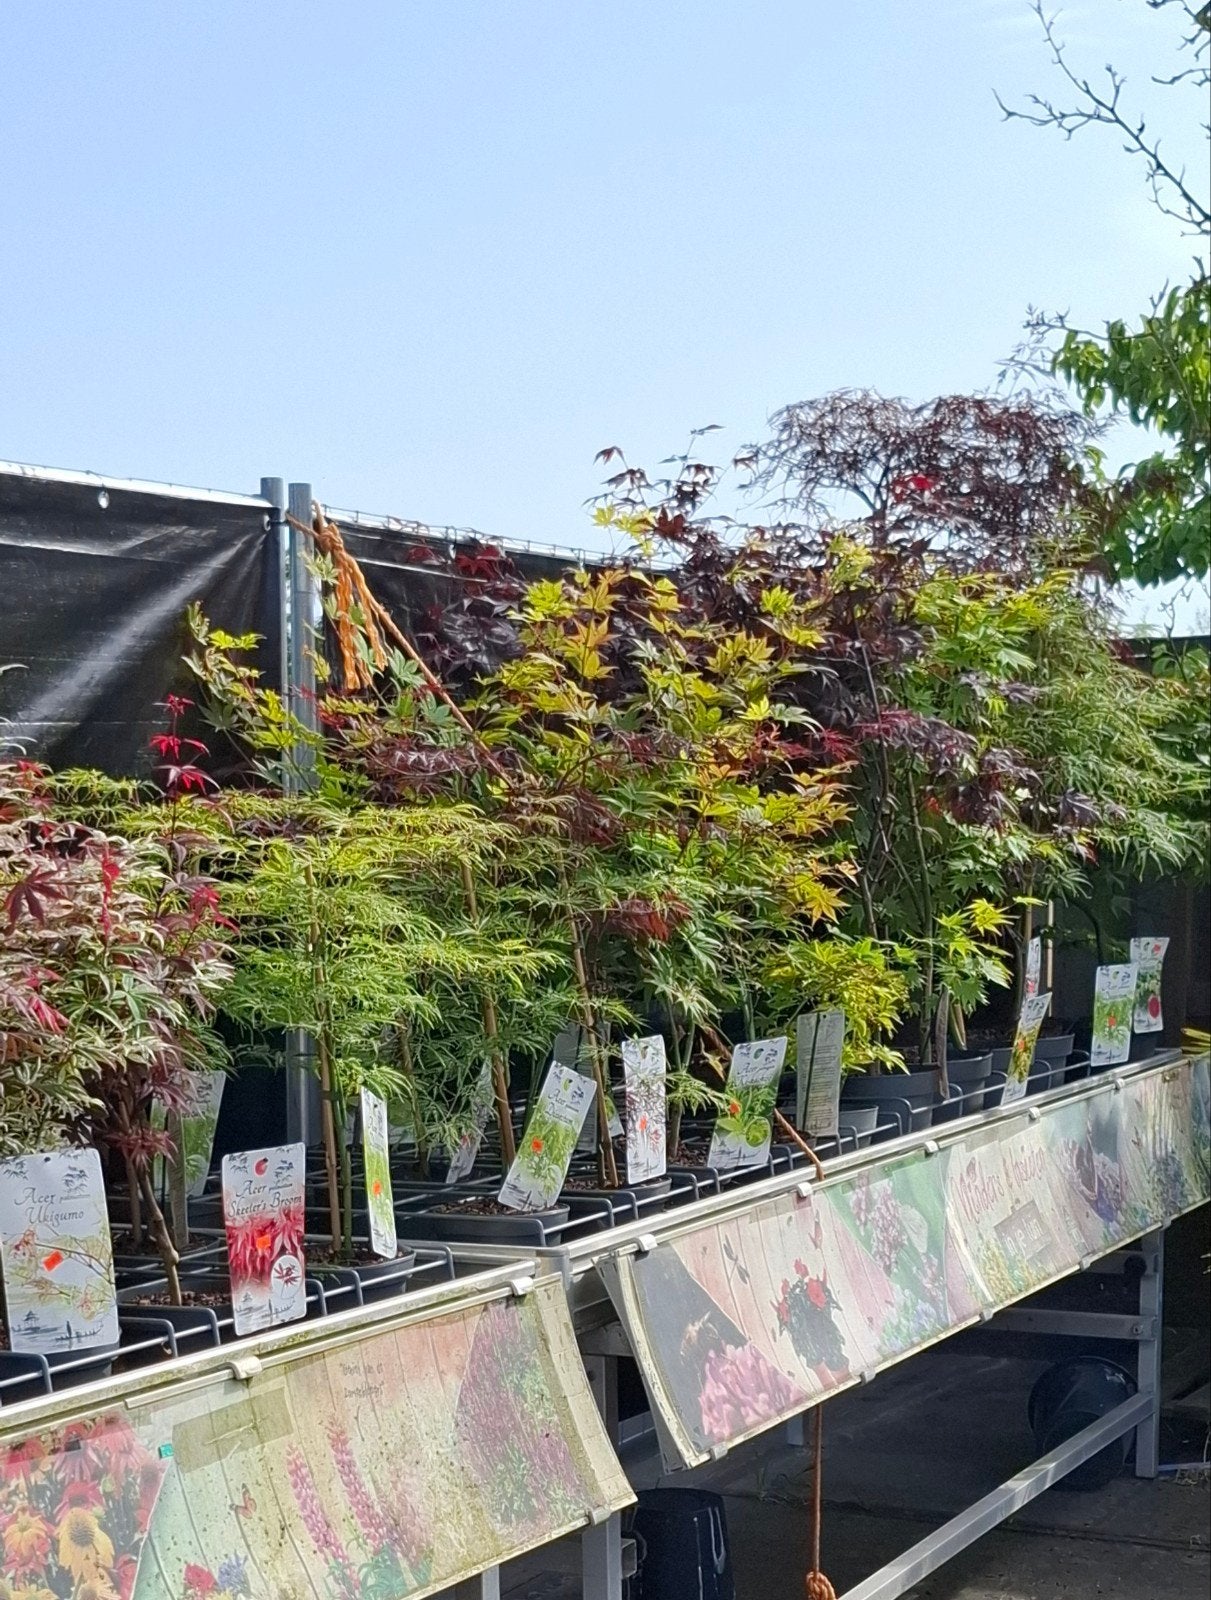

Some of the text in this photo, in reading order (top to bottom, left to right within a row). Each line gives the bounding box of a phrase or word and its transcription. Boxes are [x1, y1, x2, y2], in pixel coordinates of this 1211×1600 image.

[14, 1186, 56, 1206] Acer
[236, 1179, 267, 1197] Acer
[269, 1191, 302, 1208] Broom
[25, 1204, 84, 1227] Ukigumo
